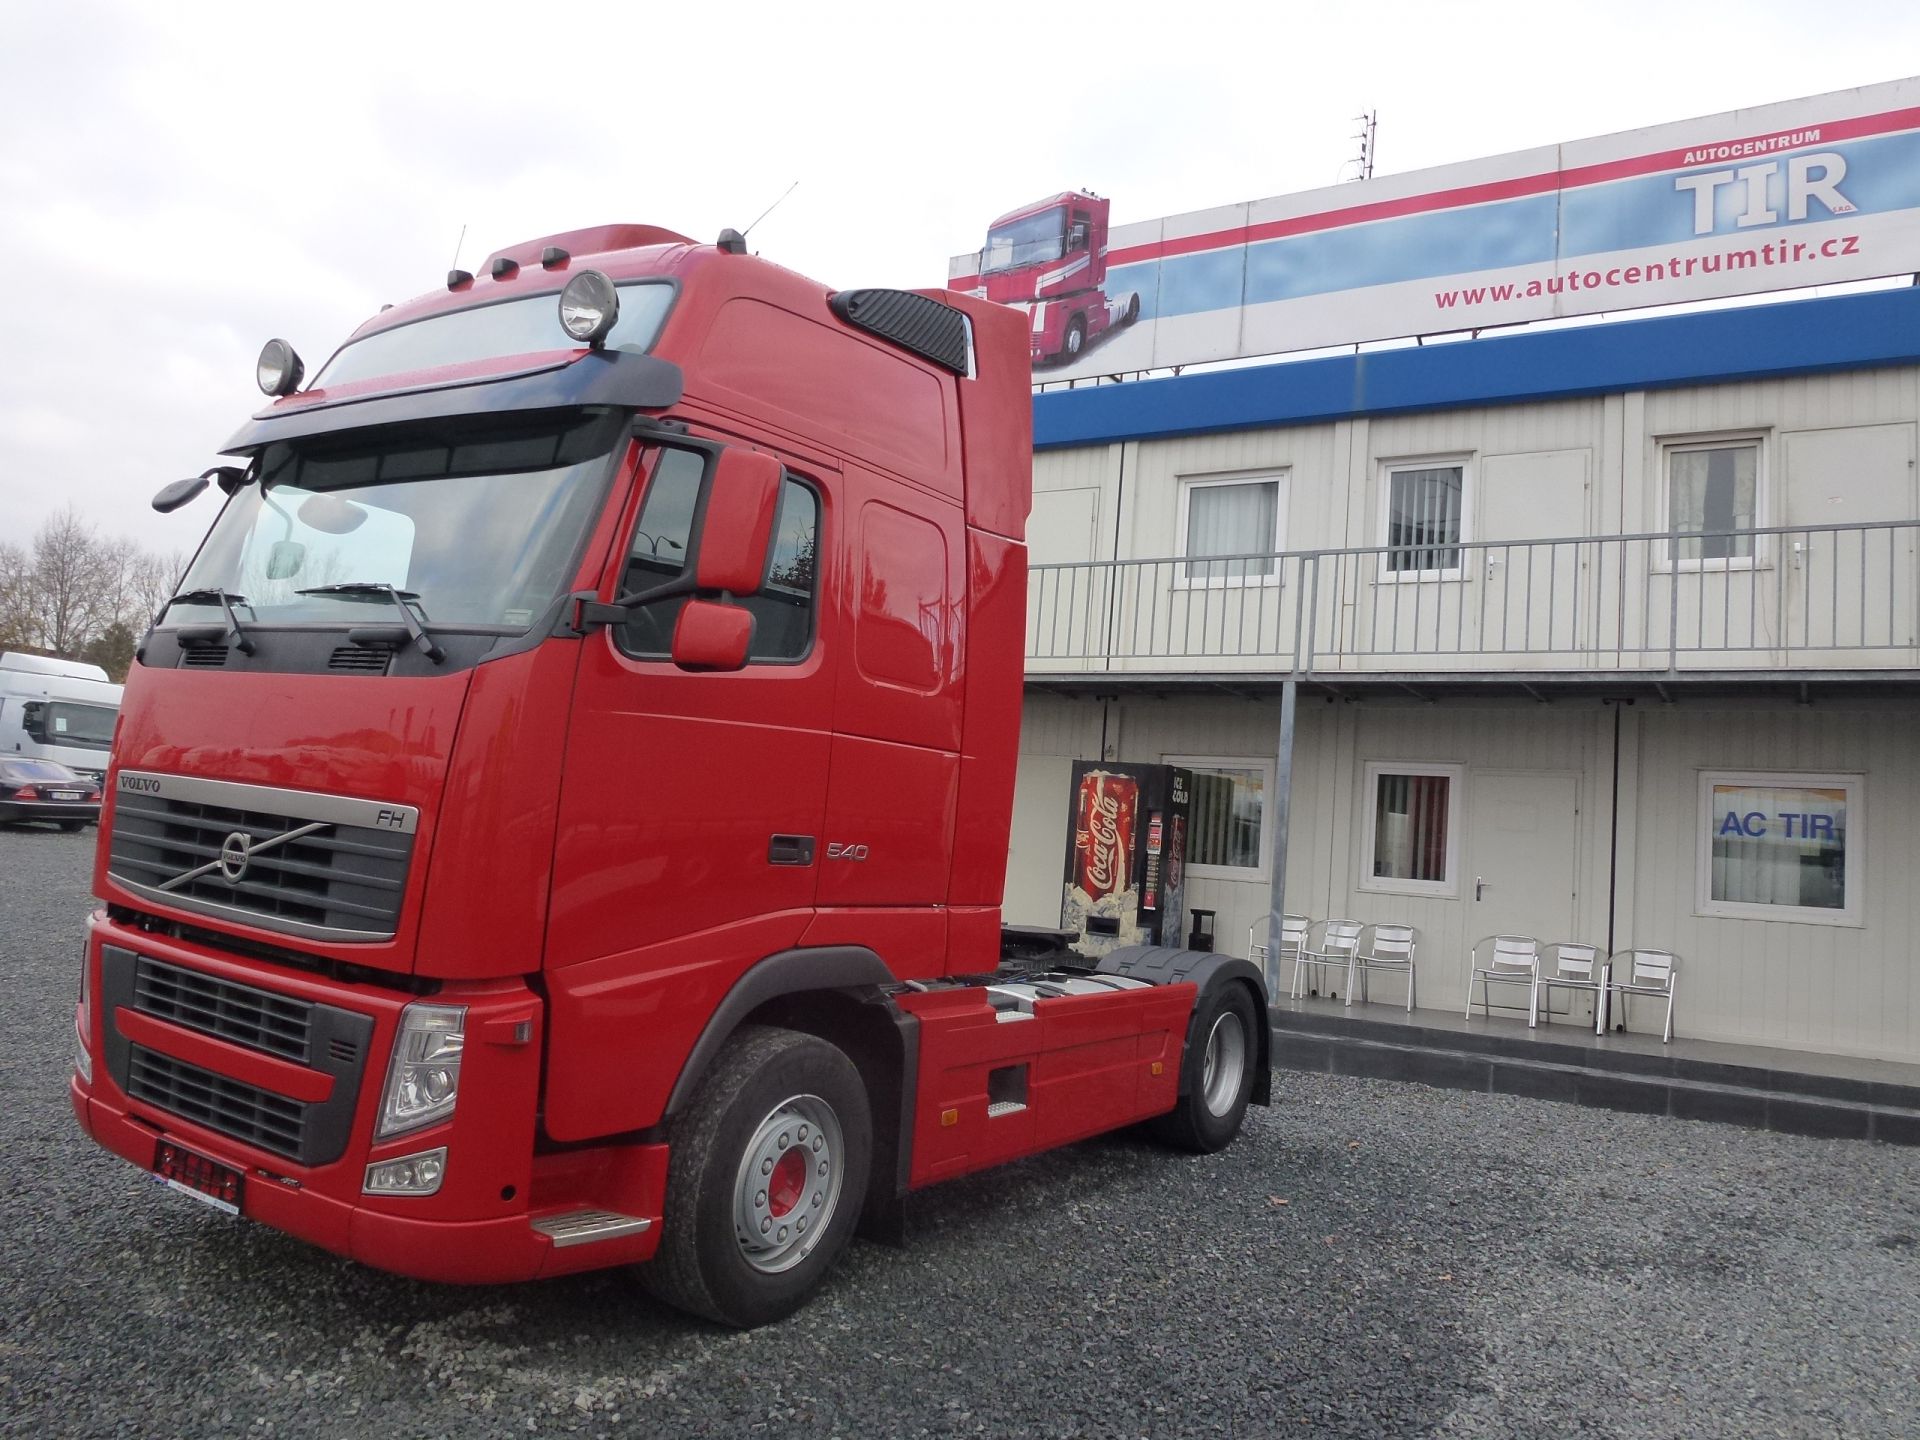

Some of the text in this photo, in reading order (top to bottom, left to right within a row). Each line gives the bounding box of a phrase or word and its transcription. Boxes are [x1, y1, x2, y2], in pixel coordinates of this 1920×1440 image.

[1683, 129, 1821, 164] AUTOCENTRUM
[1675, 152, 1859, 235] TIR
[1435, 234, 1860, 309] www.autocentrumtir.cz
[120, 776, 161, 793] VOLVO
[376, 810, 406, 829] FH
[1719, 811, 1834, 840] AC TIR
[826, 842, 869, 861] 540
